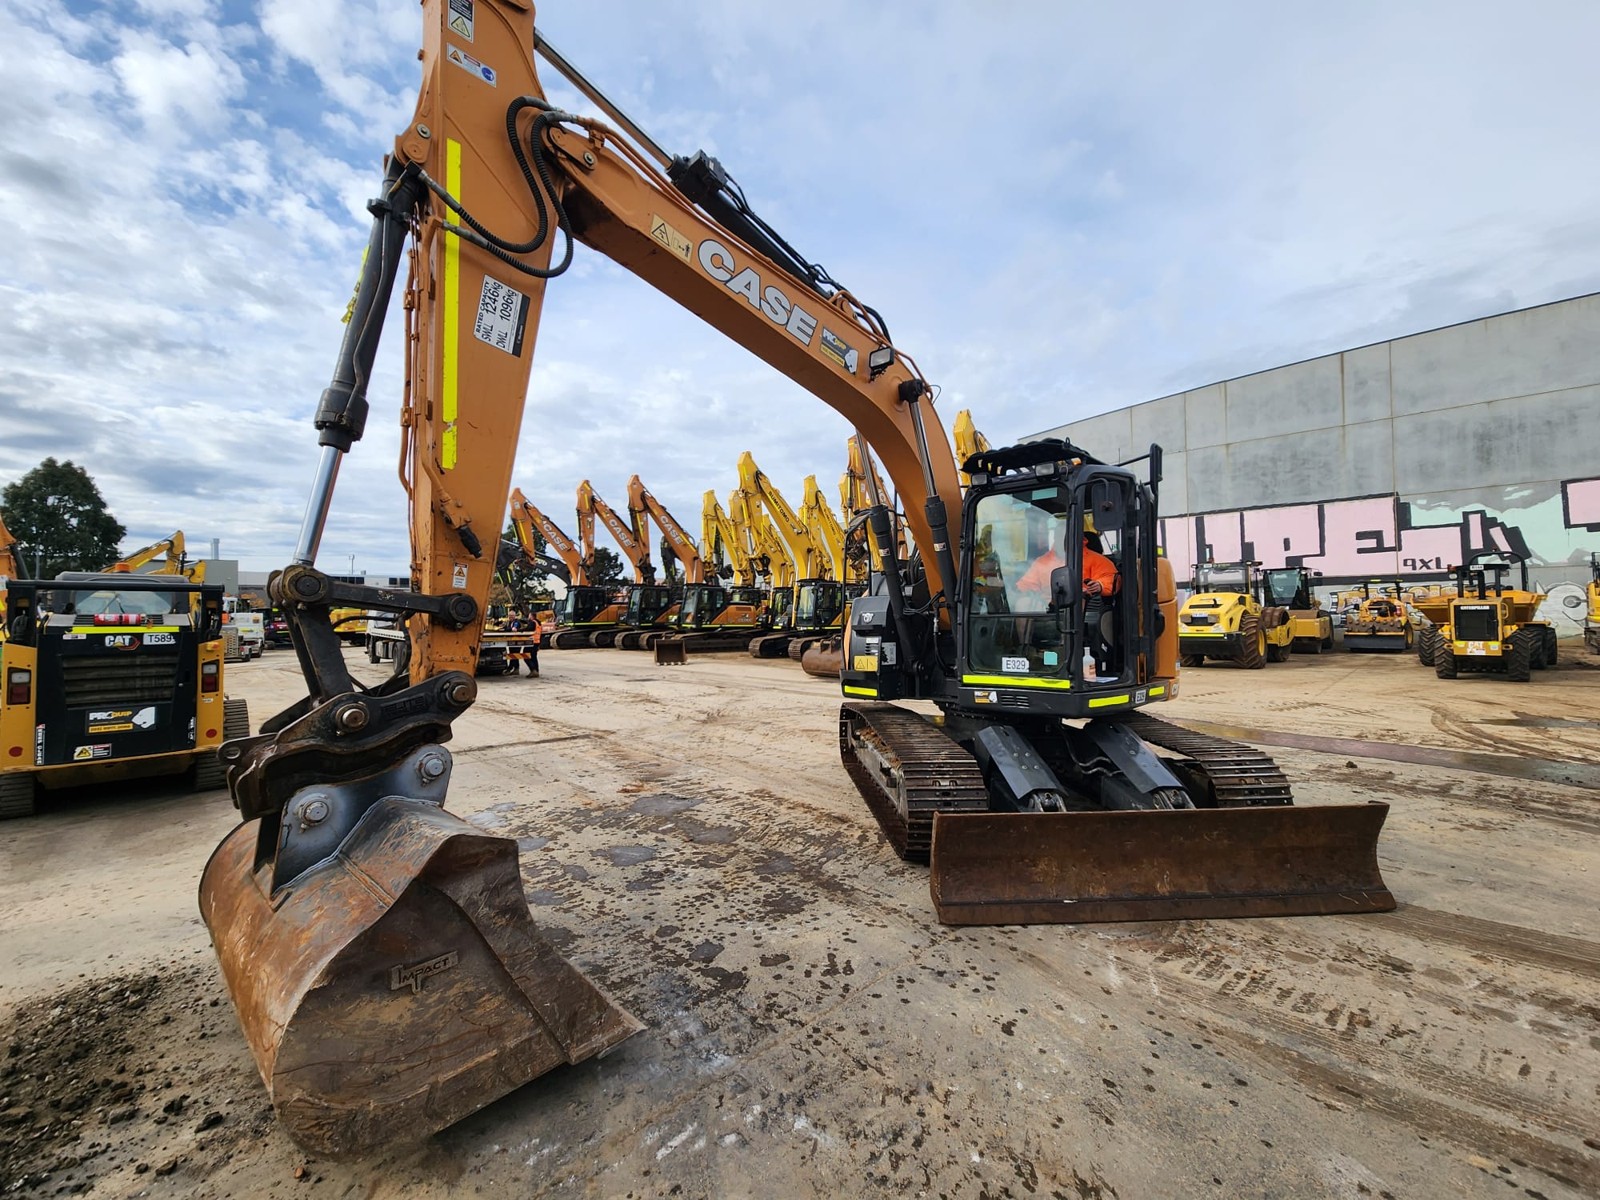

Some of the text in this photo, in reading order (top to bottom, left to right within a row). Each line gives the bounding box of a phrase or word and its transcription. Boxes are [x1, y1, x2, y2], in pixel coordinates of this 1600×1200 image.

[476, 280, 490, 333] RATED CAPACITY
[697, 238, 818, 347] CASE
[768, 491, 790, 523] SUMITOMO
[543, 523, 568, 551] CASE
[608, 518, 632, 547] CASE
[660, 515, 683, 545] CASE
[105, 634, 172, 648] CAT T589
[1006, 659, 1026, 670] E329
